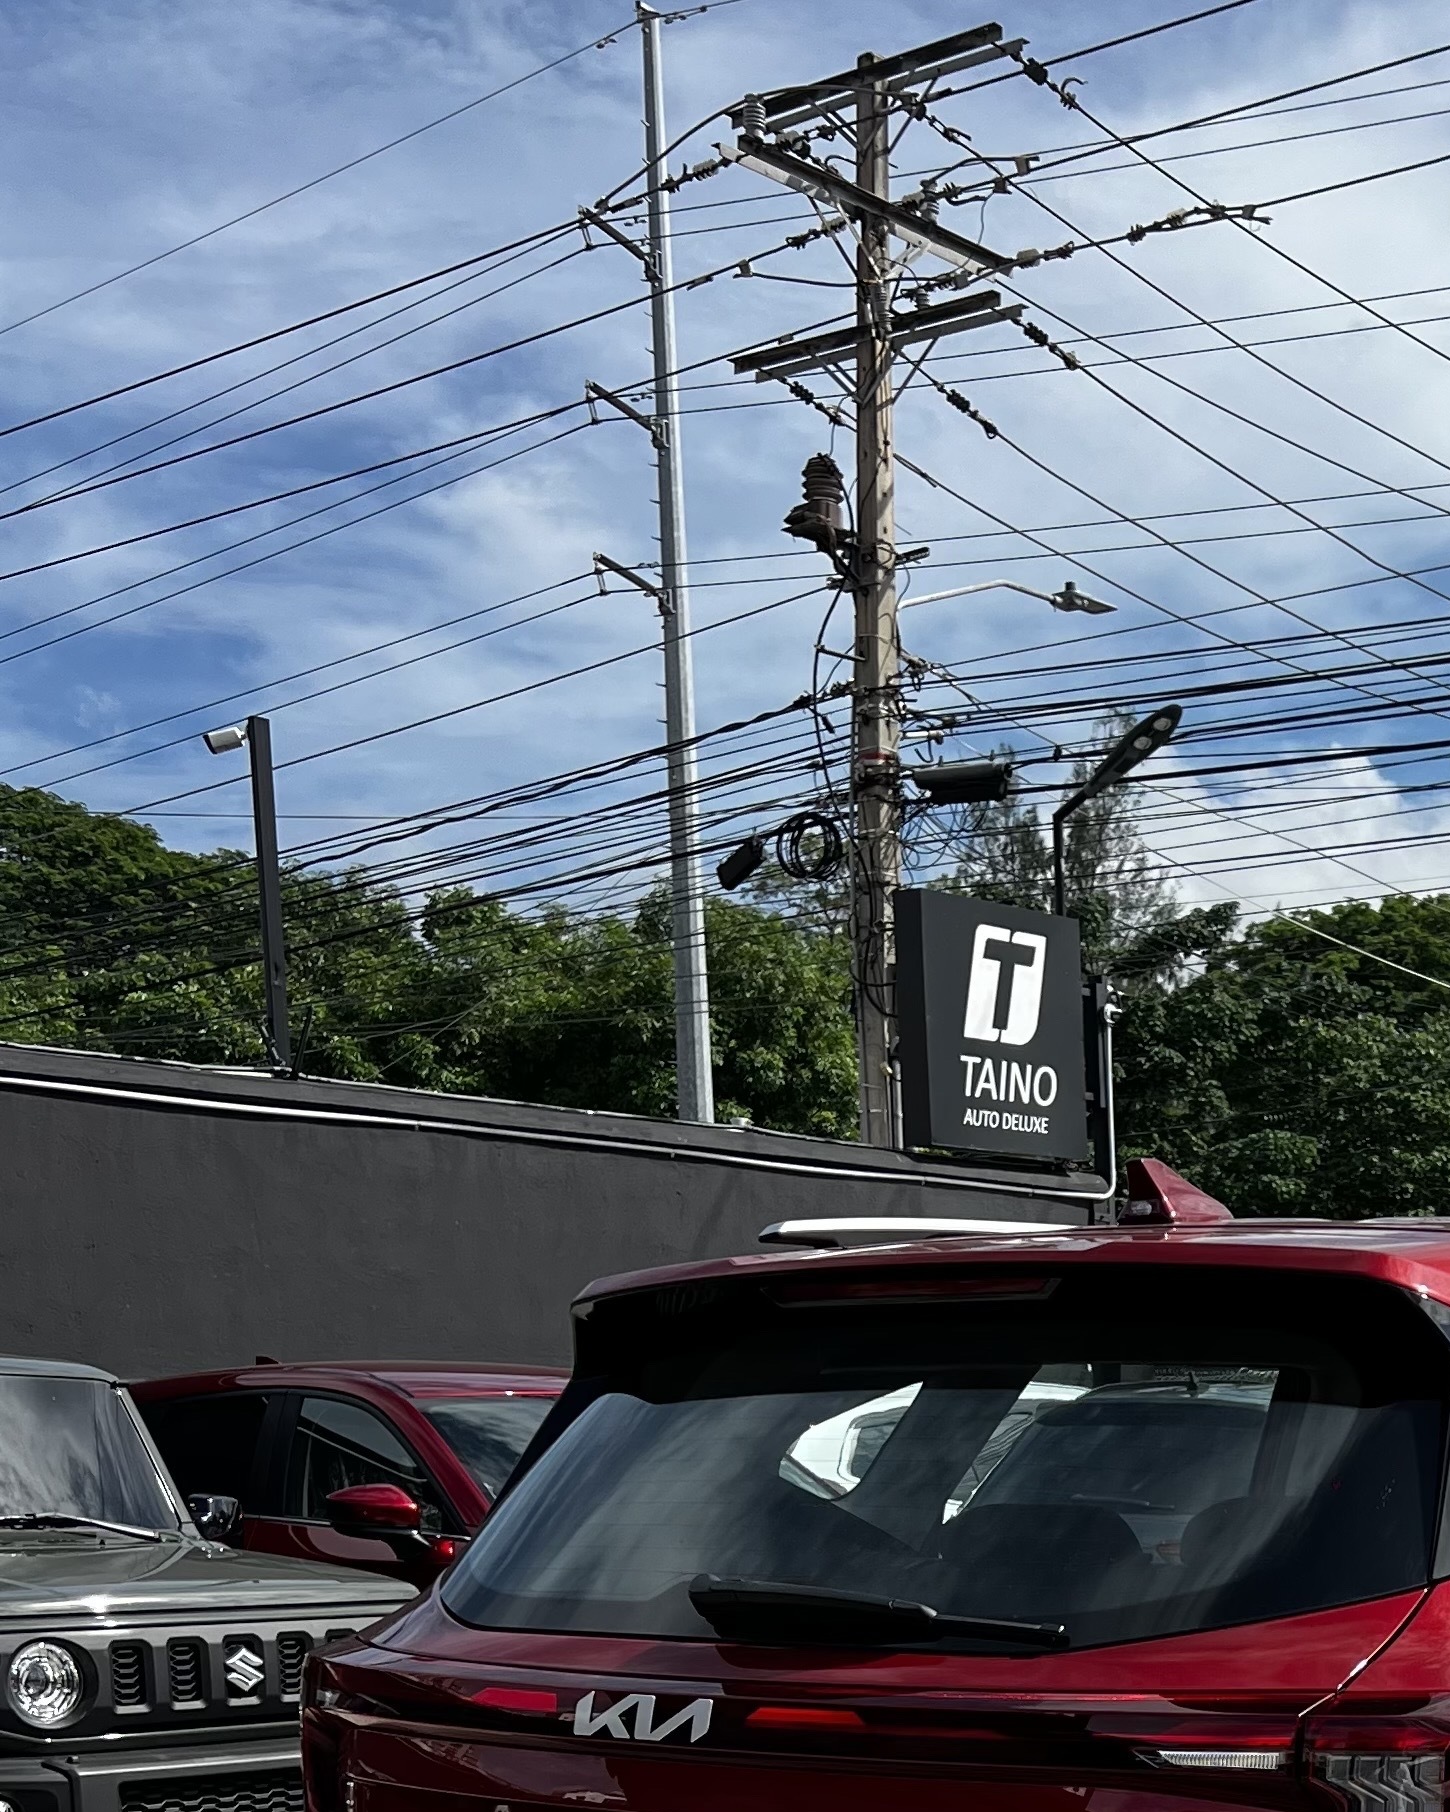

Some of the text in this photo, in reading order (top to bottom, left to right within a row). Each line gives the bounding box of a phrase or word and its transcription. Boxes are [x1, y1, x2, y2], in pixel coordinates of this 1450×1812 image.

[960, 1054, 1058, 1107] TAINO
[963, 1108, 1049, 1134] AUTO DELUXE
[573, 1690, 714, 1743] KIA
